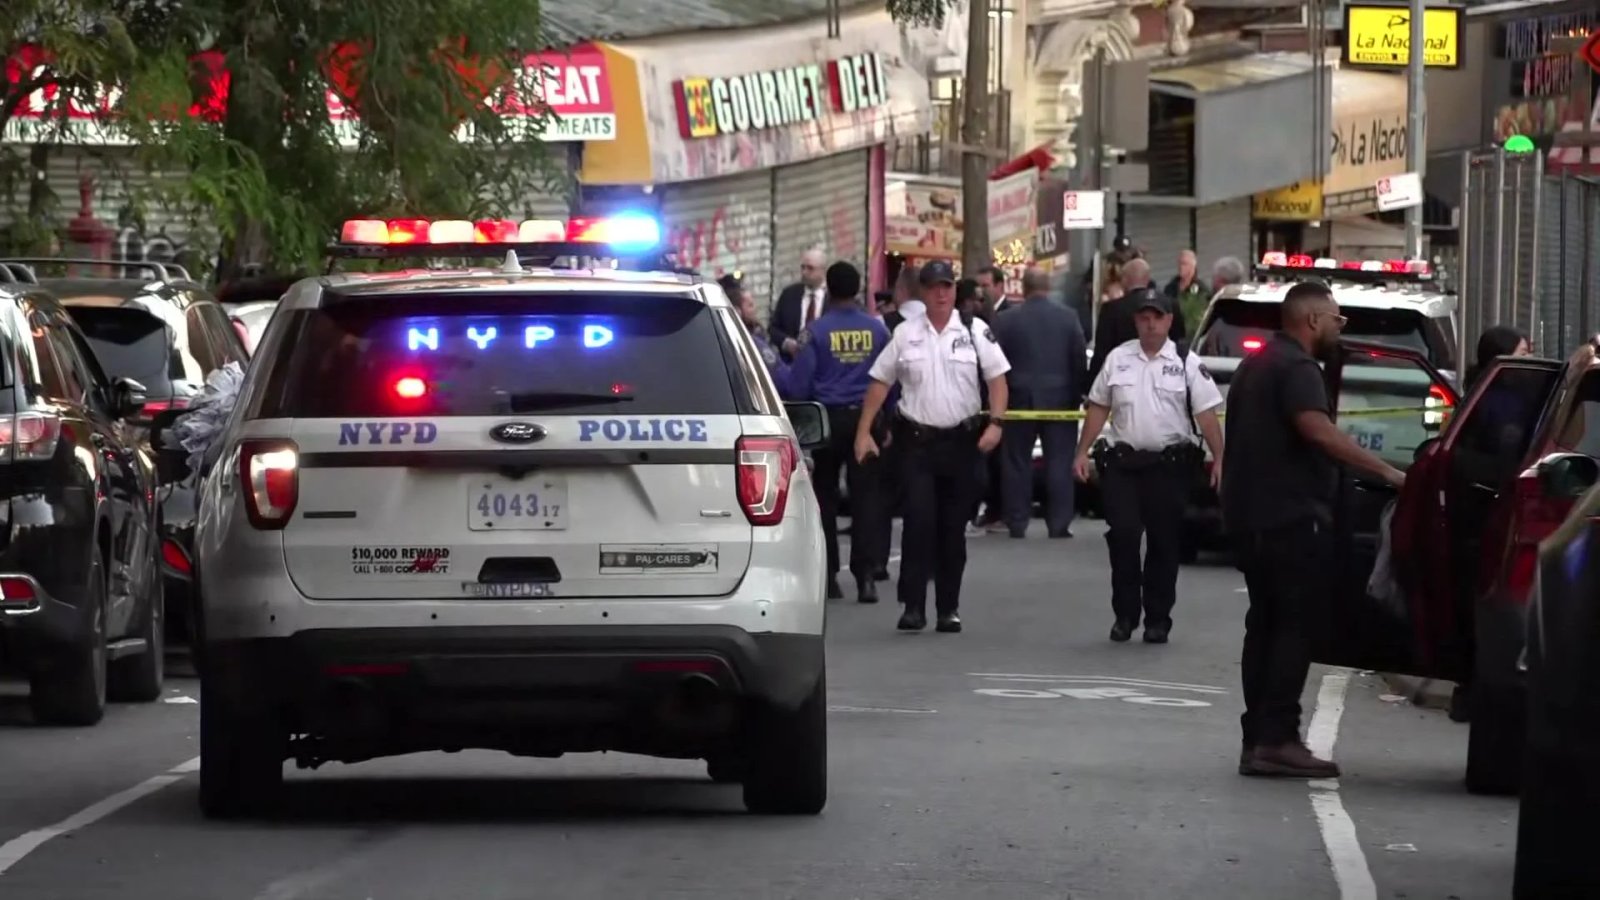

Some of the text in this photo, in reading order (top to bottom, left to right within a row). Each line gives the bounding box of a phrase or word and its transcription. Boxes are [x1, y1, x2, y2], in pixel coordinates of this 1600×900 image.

[1356, 33, 1448, 50] La Nacnal
[711, 52, 887, 134] GOURMET DELI
[556, 117, 612, 135] MEATS
[1350, 122, 1366, 166] La
[408, 325, 613, 350] NYPD
[830, 330, 873, 351] NYPD
[338, 422, 437, 445] NYPD
[578, 419, 707, 442] POLICE
[477, 493, 560, 517] 4043 17
[352, 547, 449, 564] $10,000 REWARD
[656, 555, 691, 564] CARES
[353, 565, 370, 573] CALL
